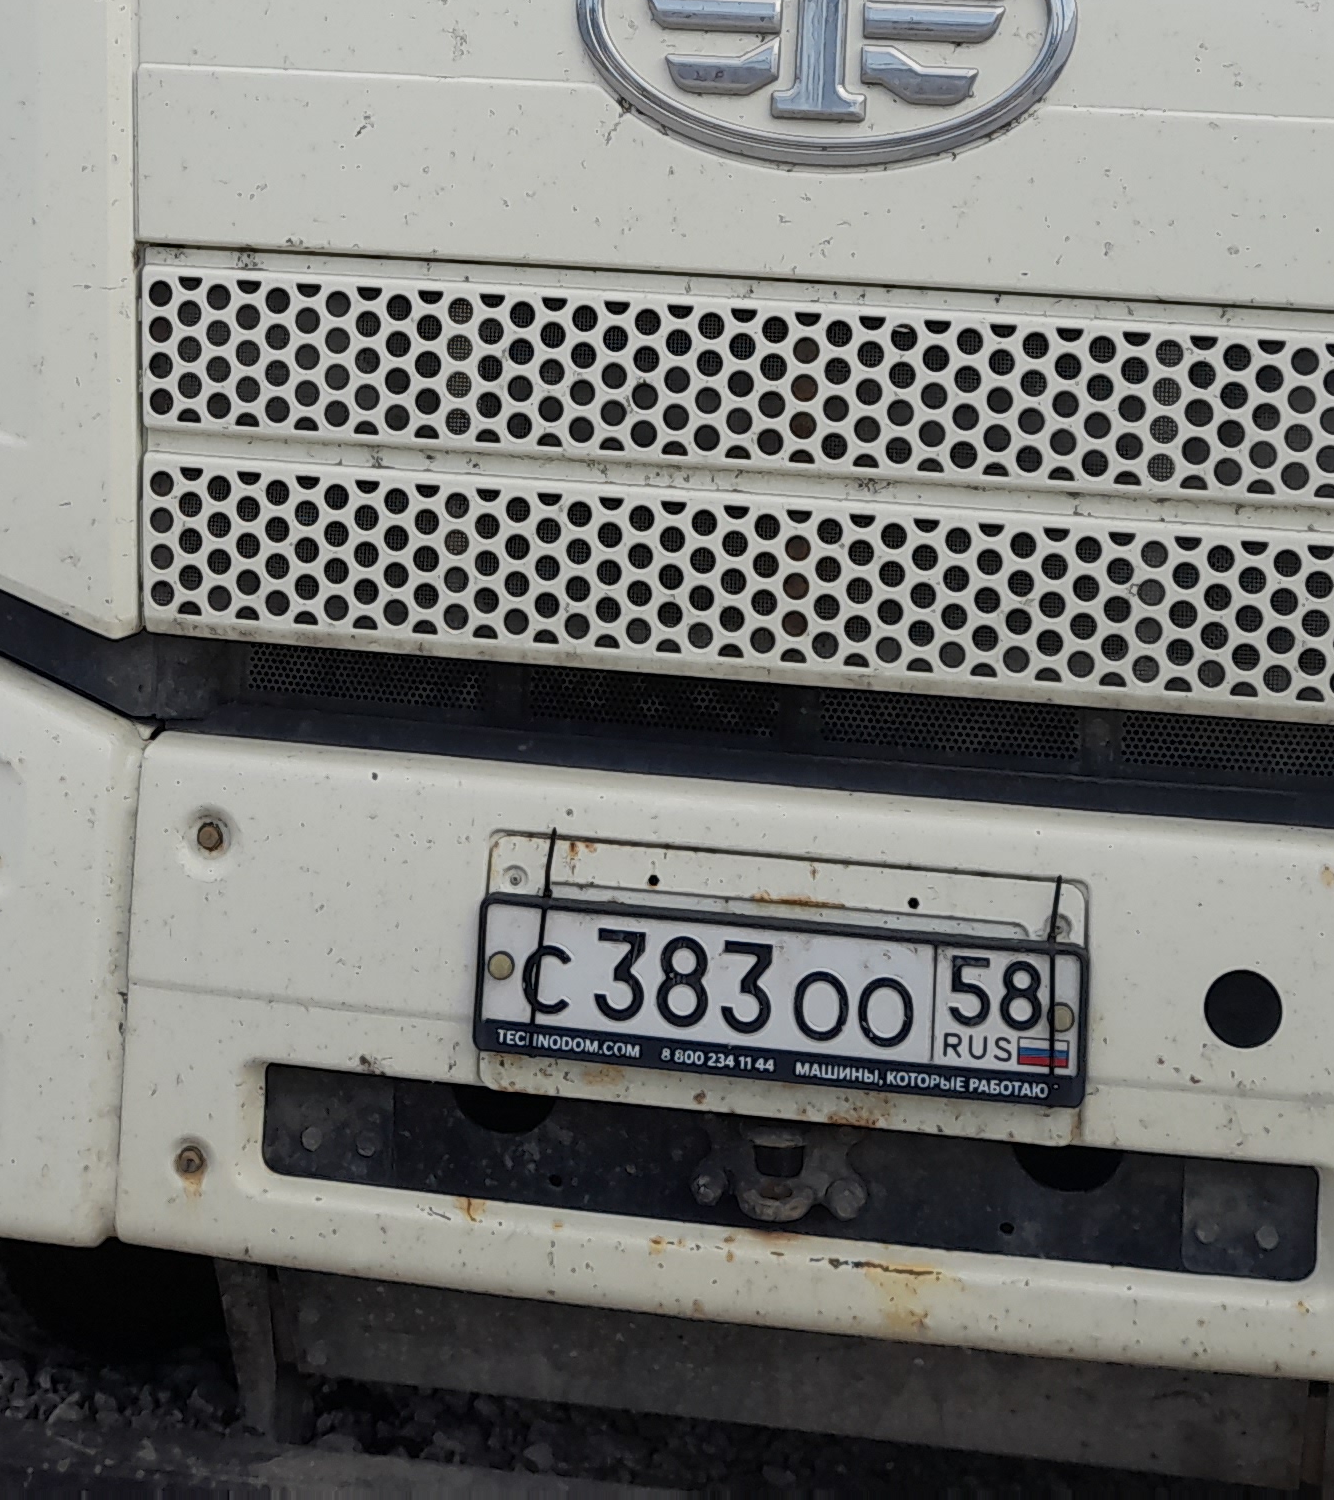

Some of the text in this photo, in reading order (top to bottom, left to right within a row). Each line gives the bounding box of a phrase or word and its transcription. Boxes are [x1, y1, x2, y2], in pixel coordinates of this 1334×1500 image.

[948, 955, 1043, 1032] 58
[661, 1047, 775, 1073] 8 800 234 11 44
[942, 1032, 1013, 1062] RUS
[795, 1061, 1059, 1099] МАШИНЫ, КОТОРЫЕ РАБОТАЮ
